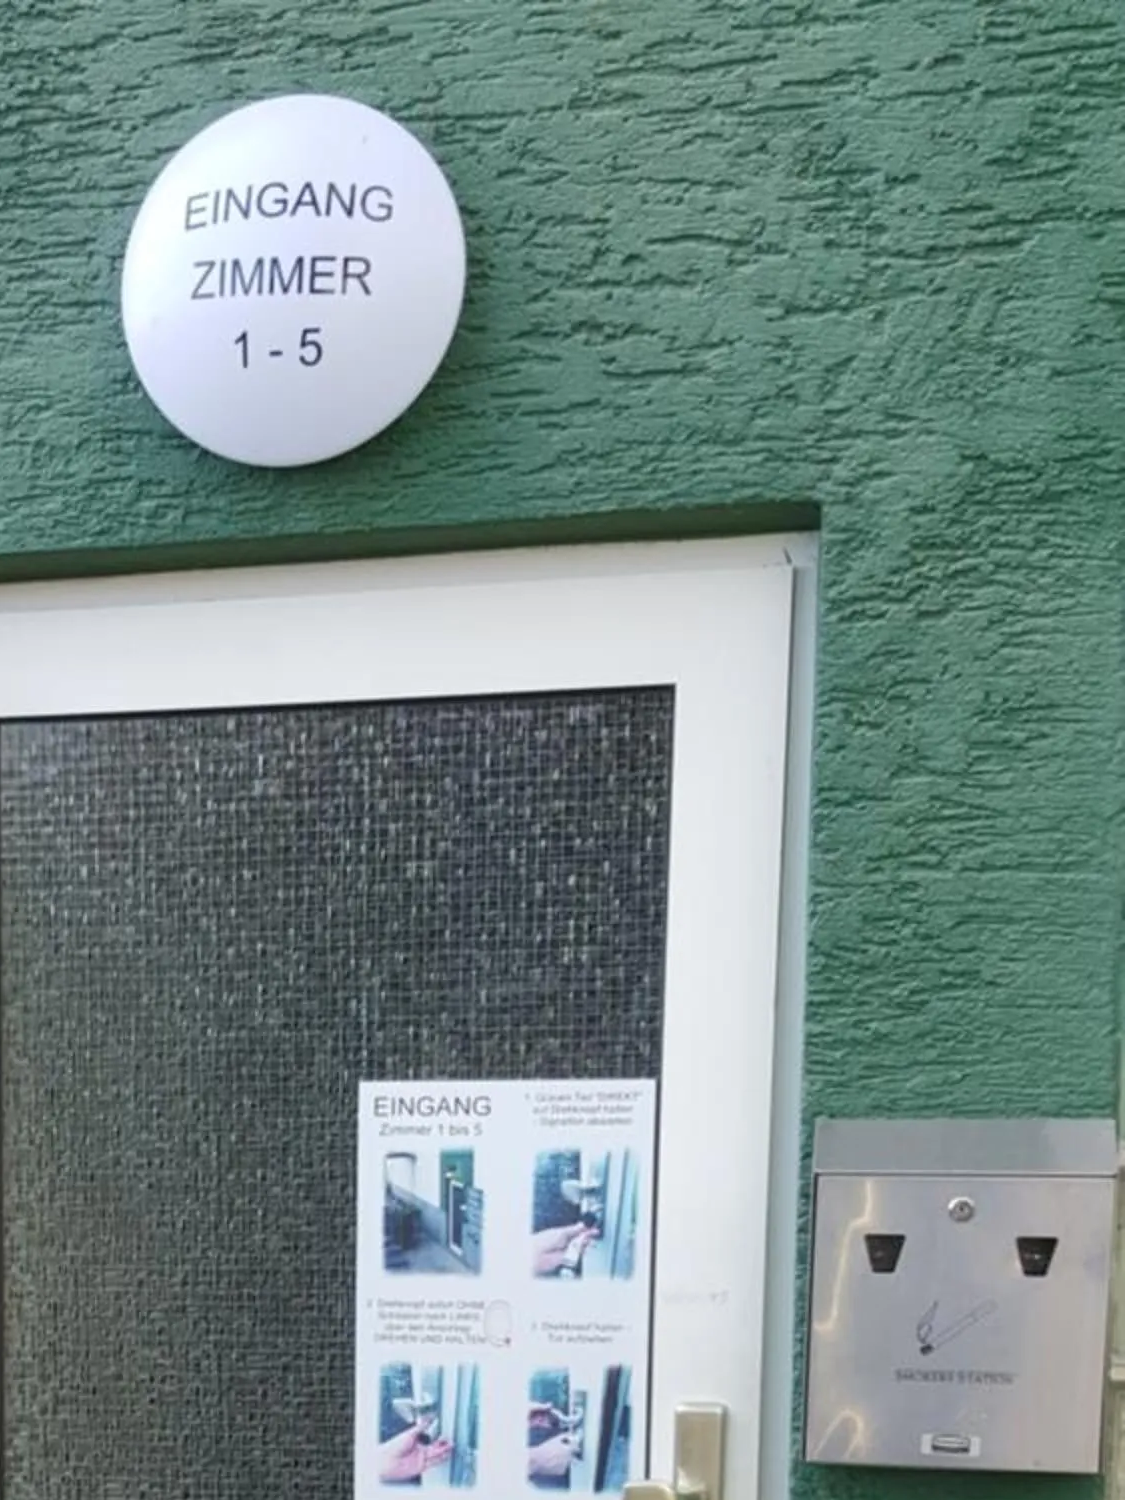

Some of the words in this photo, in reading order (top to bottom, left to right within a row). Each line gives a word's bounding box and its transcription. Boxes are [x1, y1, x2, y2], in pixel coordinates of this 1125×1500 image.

[182, 180, 394, 233] EINGANG
[190, 255, 373, 300] ZIMMER
[233, 331, 249, 369] 1
[298, 327, 323, 367] 5
[373, 1095, 492, 1117] EINGANG
[378, 1122, 432, 1136] Zimmer
[472, 1121, 483, 1136] 5
